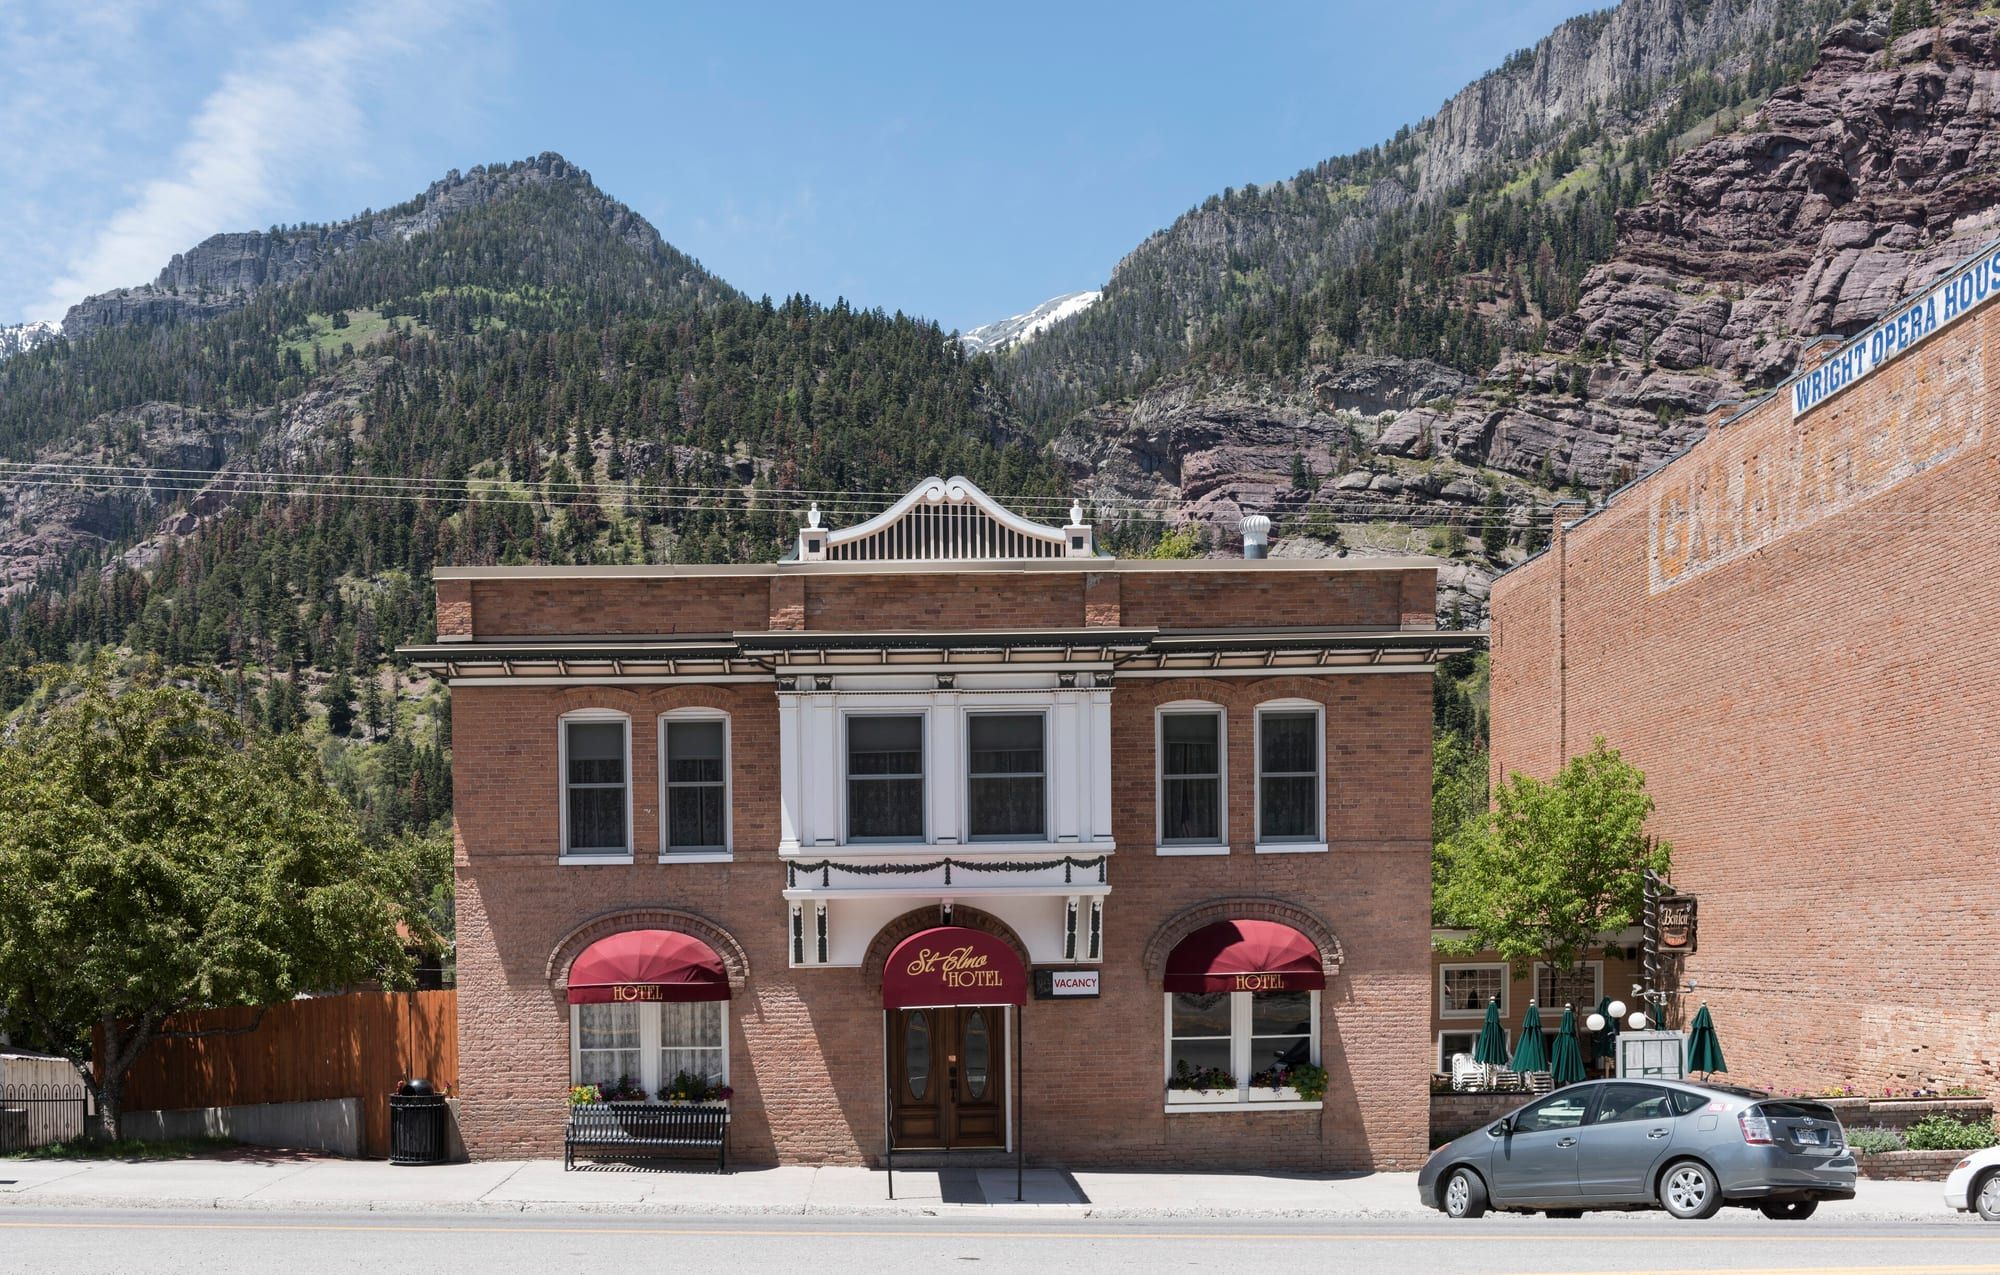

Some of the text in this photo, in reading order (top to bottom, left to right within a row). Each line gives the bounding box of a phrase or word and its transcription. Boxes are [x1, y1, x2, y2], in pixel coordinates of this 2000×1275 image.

[1796, 341, 1867, 412] WRIGHT
[1871, 296, 1937, 366] OPERA
[907, 945, 988, 981] St. Elmo
[947, 970, 1003, 987] HOTEL
[1054, 978, 1097, 988] VACANCY
[1235, 974, 1285, 990] HOTEL
[613, 985, 663, 1000] HOTEL
